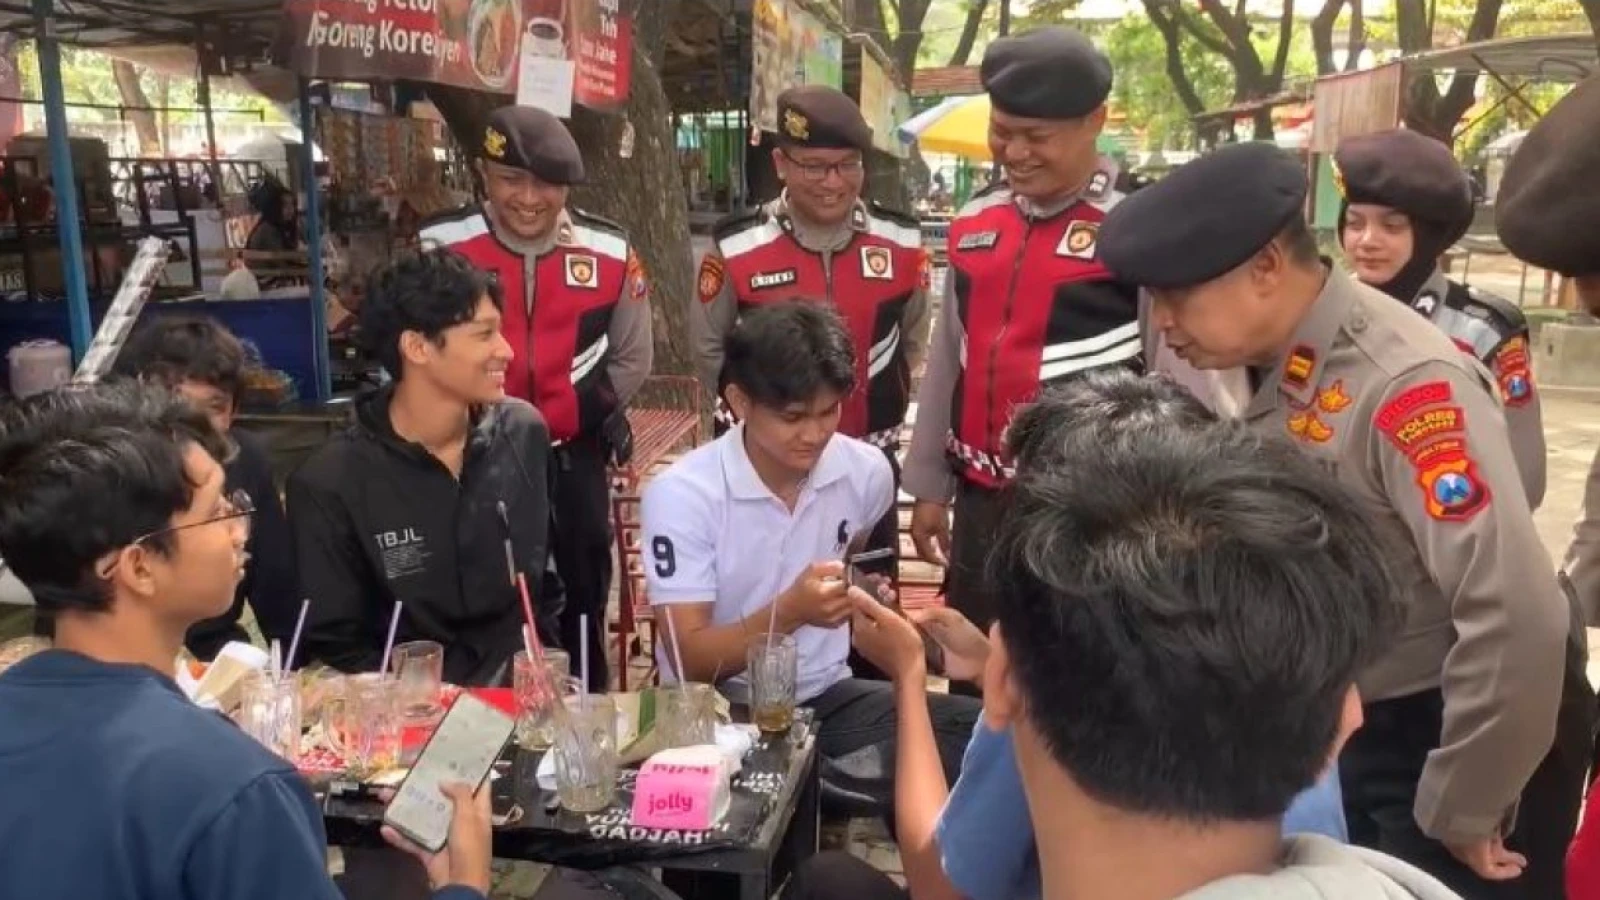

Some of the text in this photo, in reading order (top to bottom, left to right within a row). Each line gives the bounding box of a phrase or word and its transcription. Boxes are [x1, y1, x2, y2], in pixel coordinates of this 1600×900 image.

[374, 528, 424, 549] TBJL
[652, 535, 676, 578] 9
[647, 793, 693, 816] jolly
